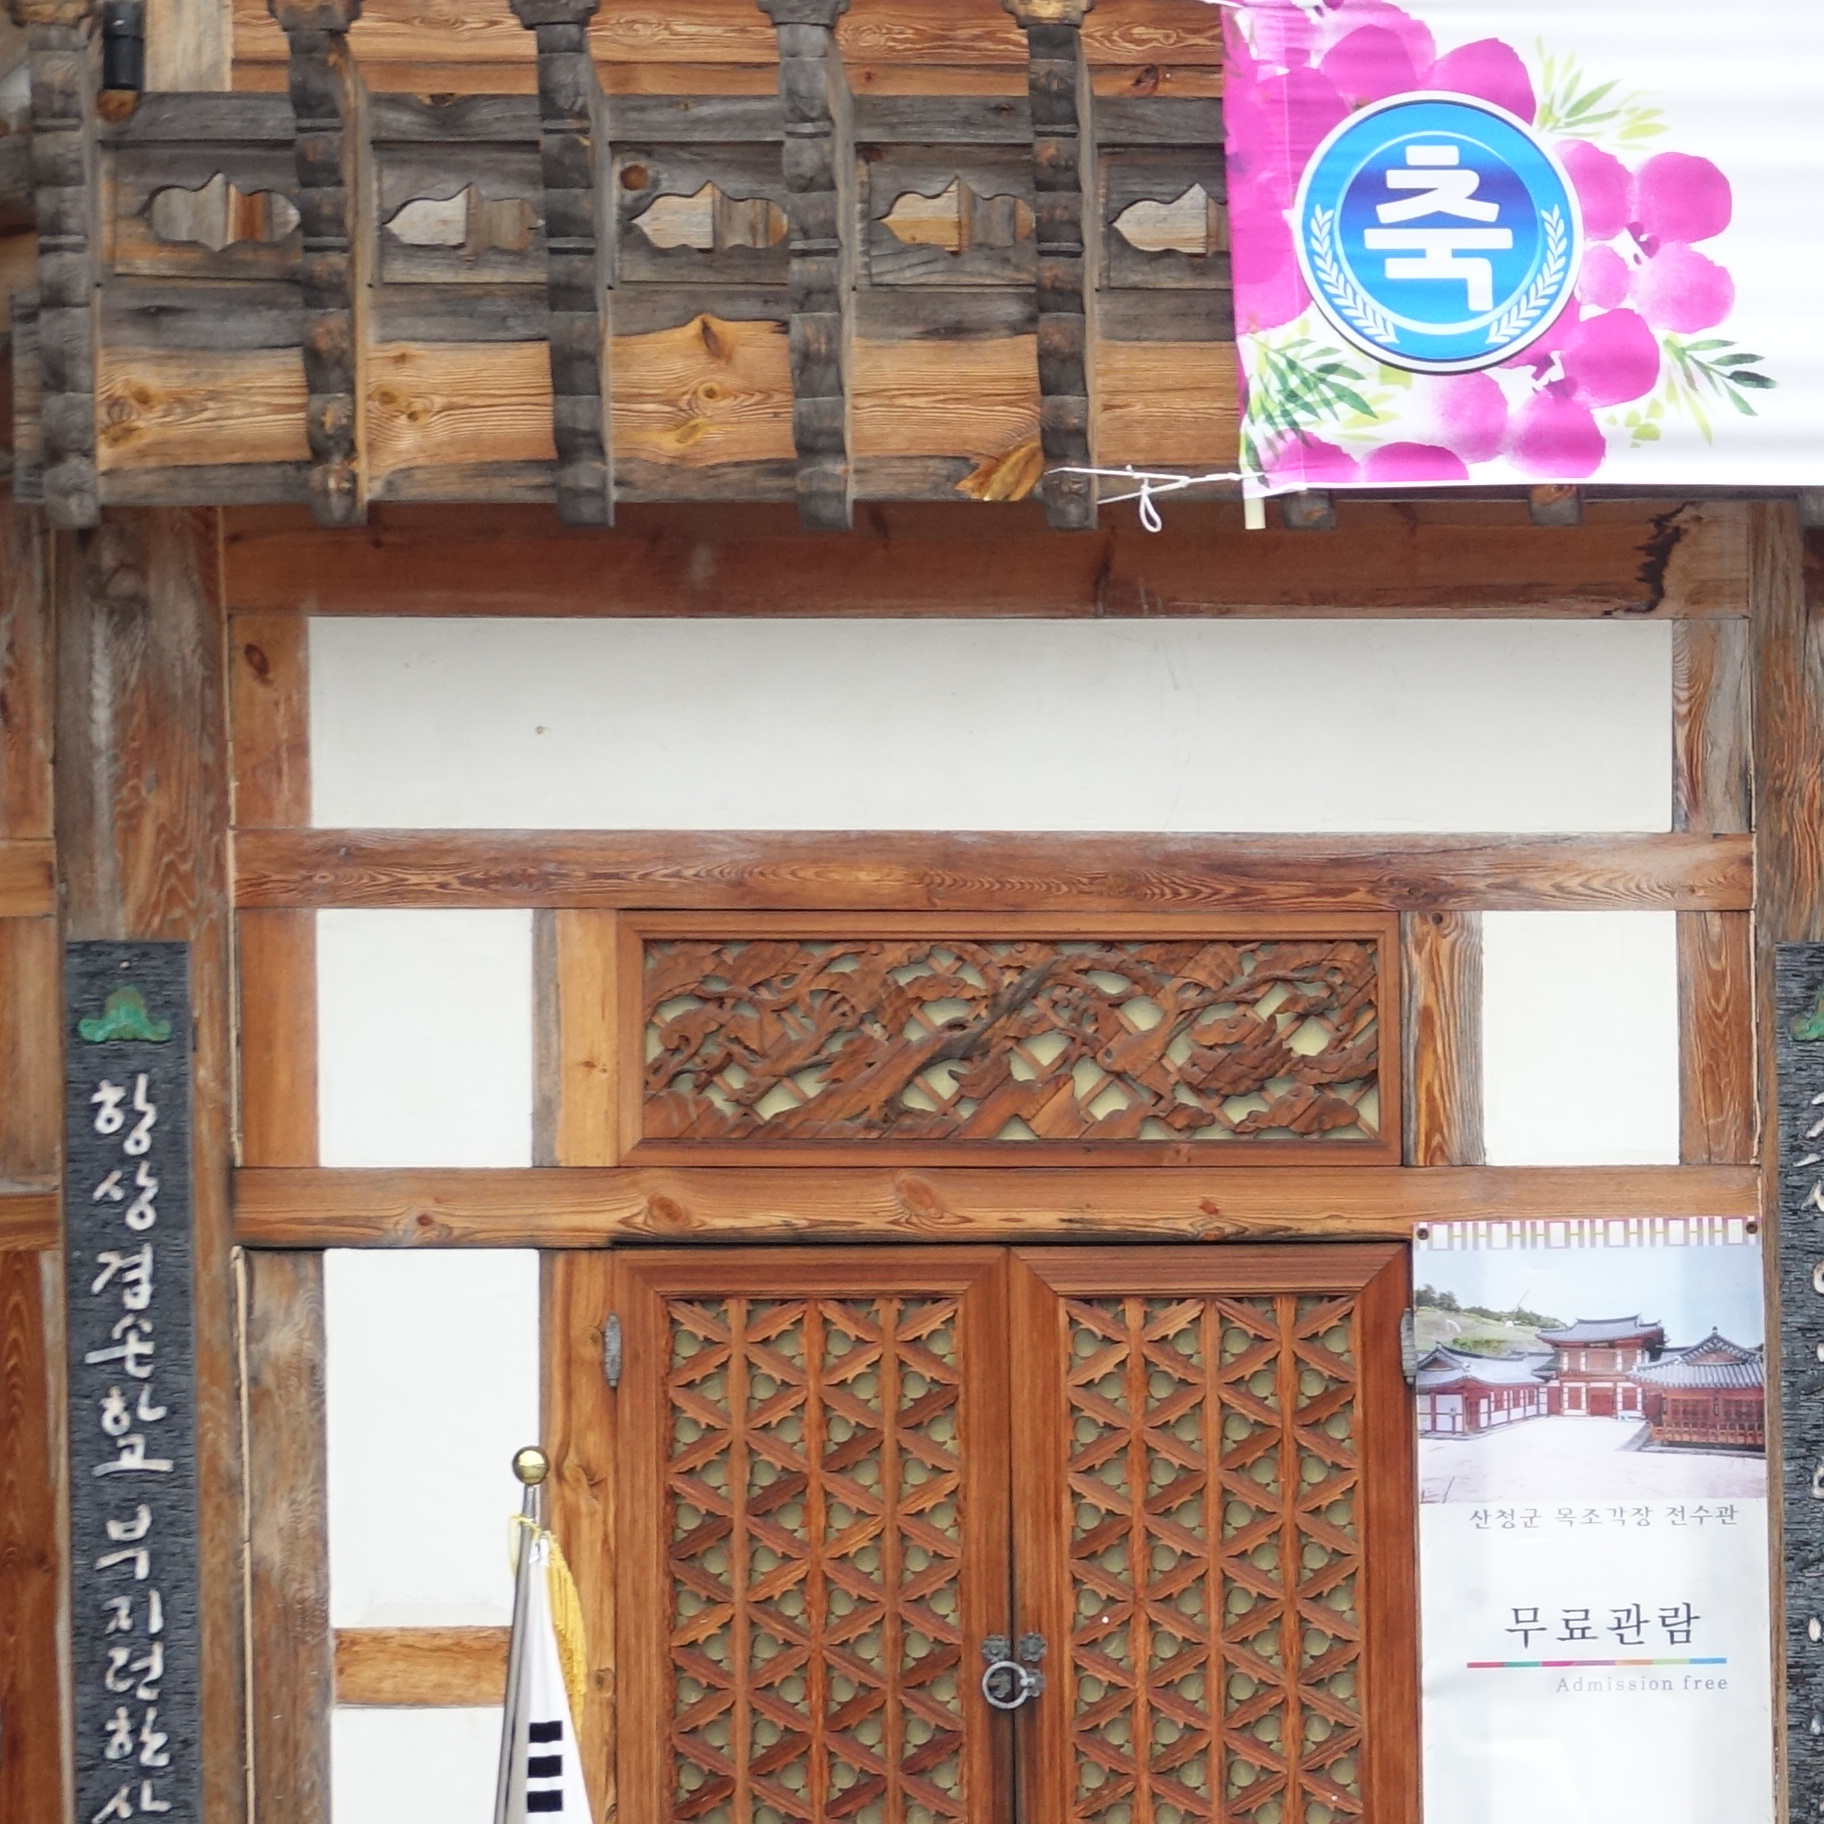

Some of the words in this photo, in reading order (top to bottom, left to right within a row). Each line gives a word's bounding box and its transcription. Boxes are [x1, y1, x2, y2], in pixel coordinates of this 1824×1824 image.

[1363, 144, 1514, 312] 축
[1469, 1508, 1542, 1530] 산청군
[1554, 1506, 1654, 1529] 목조각장
[1665, 1504, 1739, 1526] 전수관
[1504, 1602, 1702, 1649] 무료관람
[1555, 1676, 1674, 1693] Admission
[1682, 1674, 1728, 1691] free
